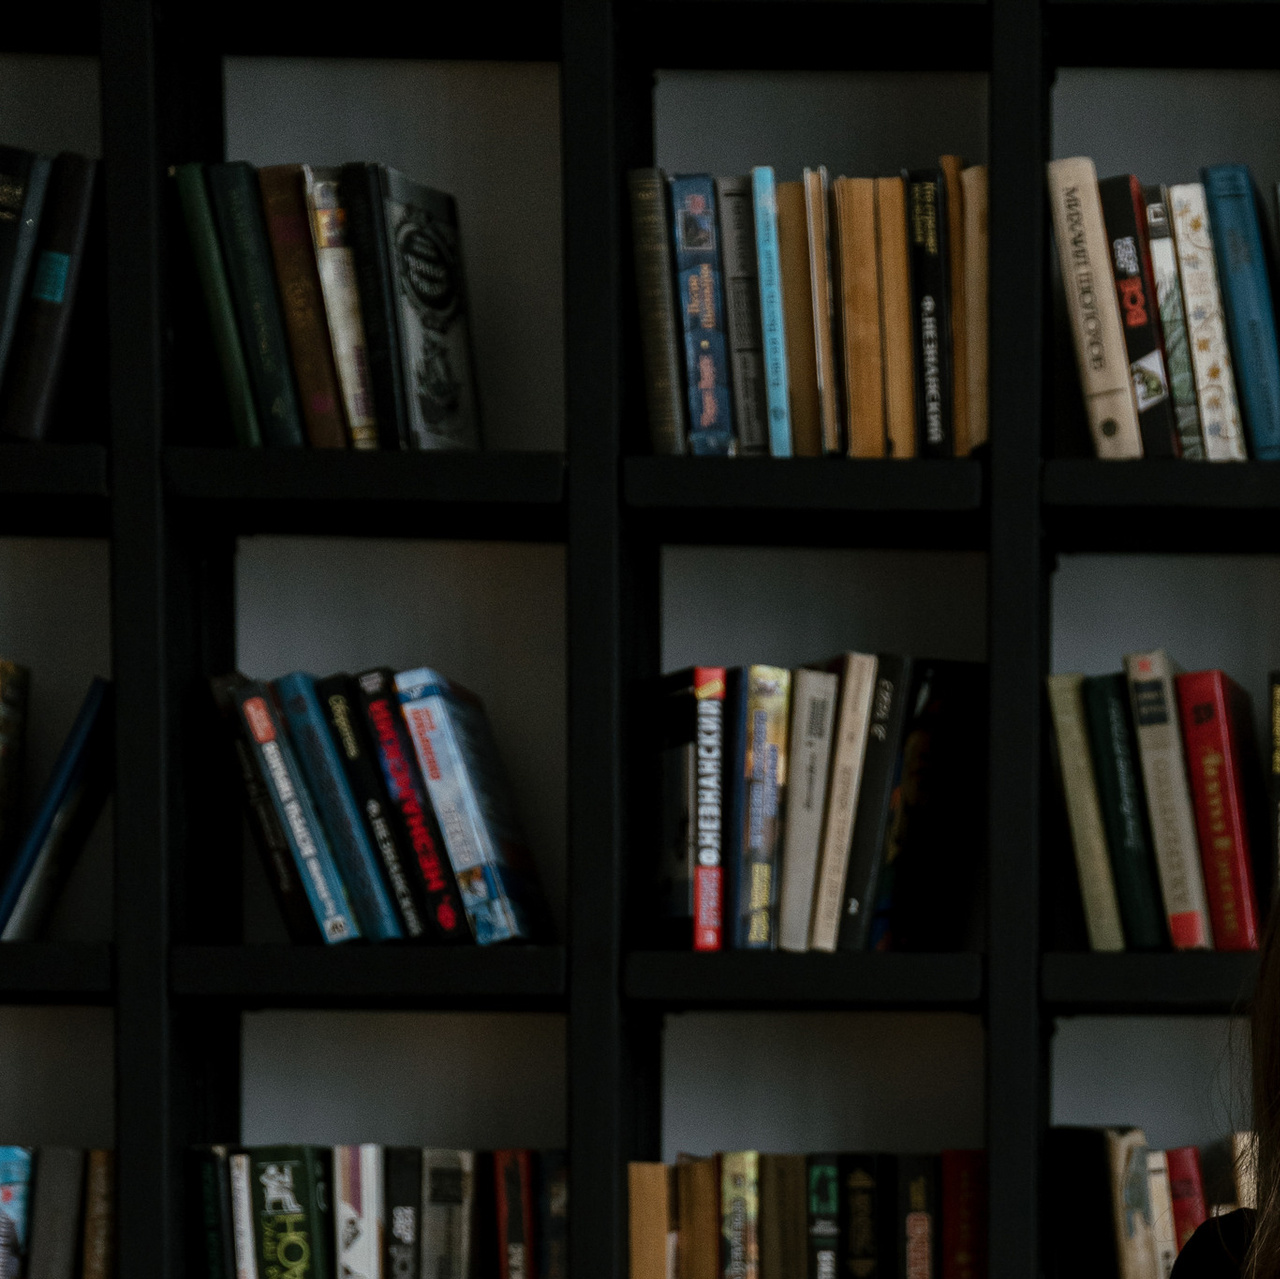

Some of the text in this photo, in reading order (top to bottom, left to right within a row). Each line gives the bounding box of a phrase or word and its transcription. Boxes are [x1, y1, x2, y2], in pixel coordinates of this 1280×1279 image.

[1061, 185, 1109, 372] МИХАИЛ ШОЛОХОВ
[365, 696, 447, 894] НЕЗНАНСКИЙ
